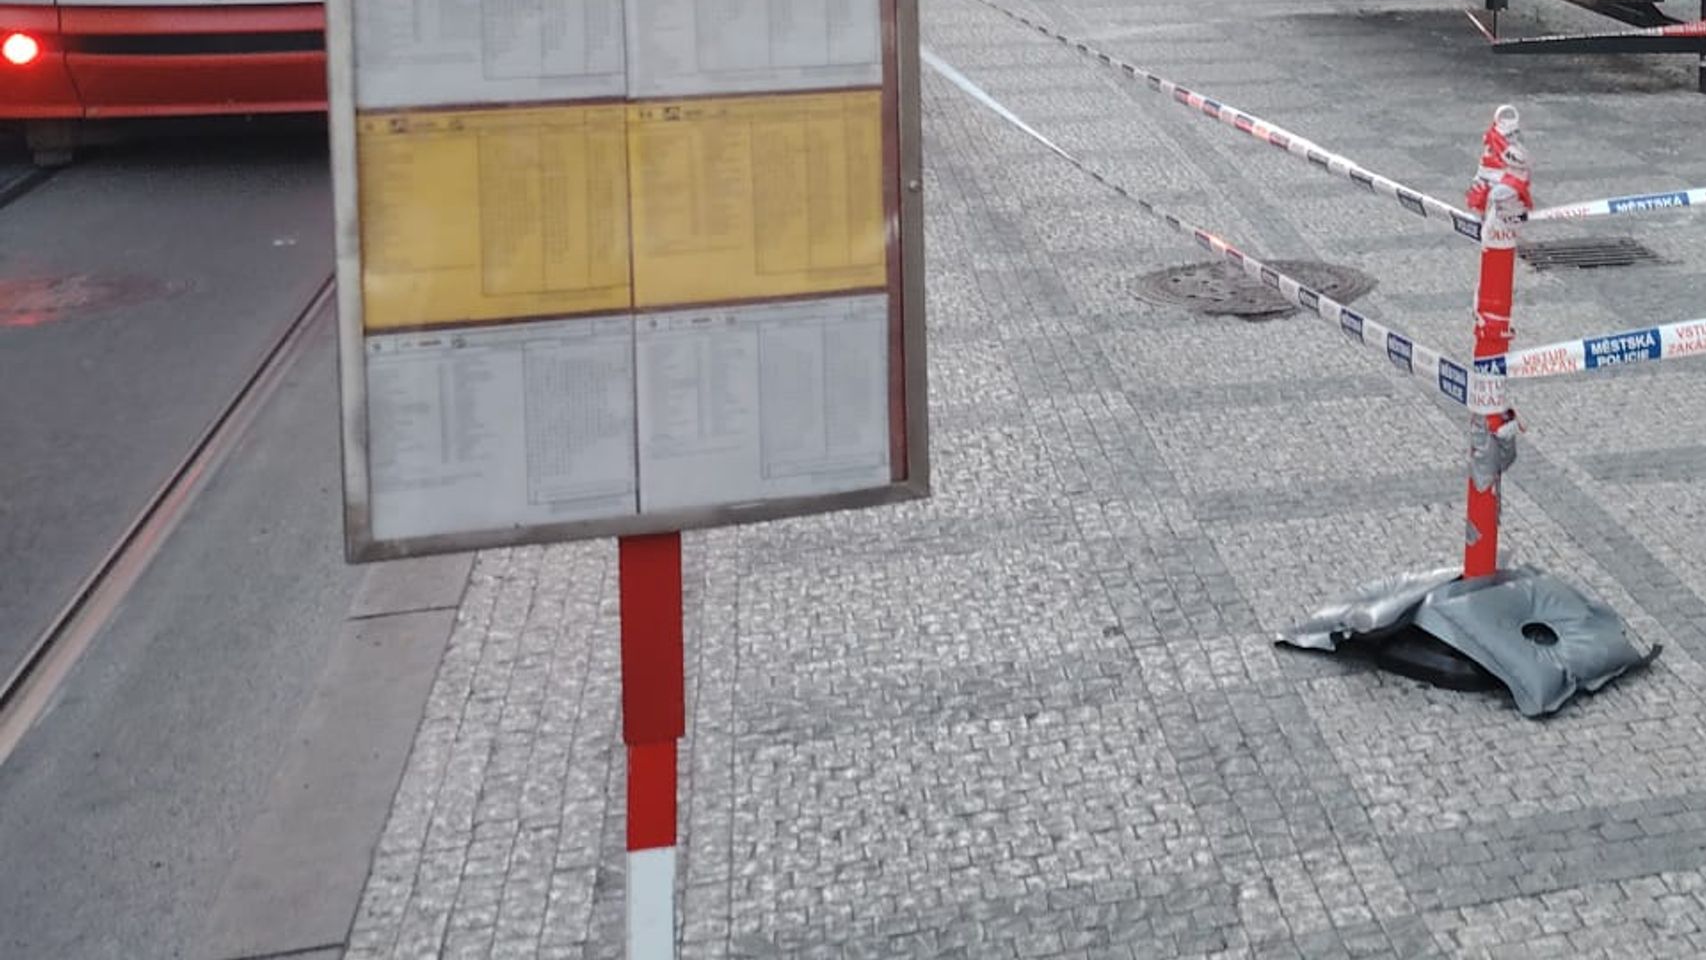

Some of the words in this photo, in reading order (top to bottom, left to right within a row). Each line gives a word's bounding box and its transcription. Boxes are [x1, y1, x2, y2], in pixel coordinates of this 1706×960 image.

[1592, 332, 1655, 355] MĚSTSKÁ
[1523, 348, 1567, 365] VSTUP
[1598, 349, 1649, 367] POLICIE
